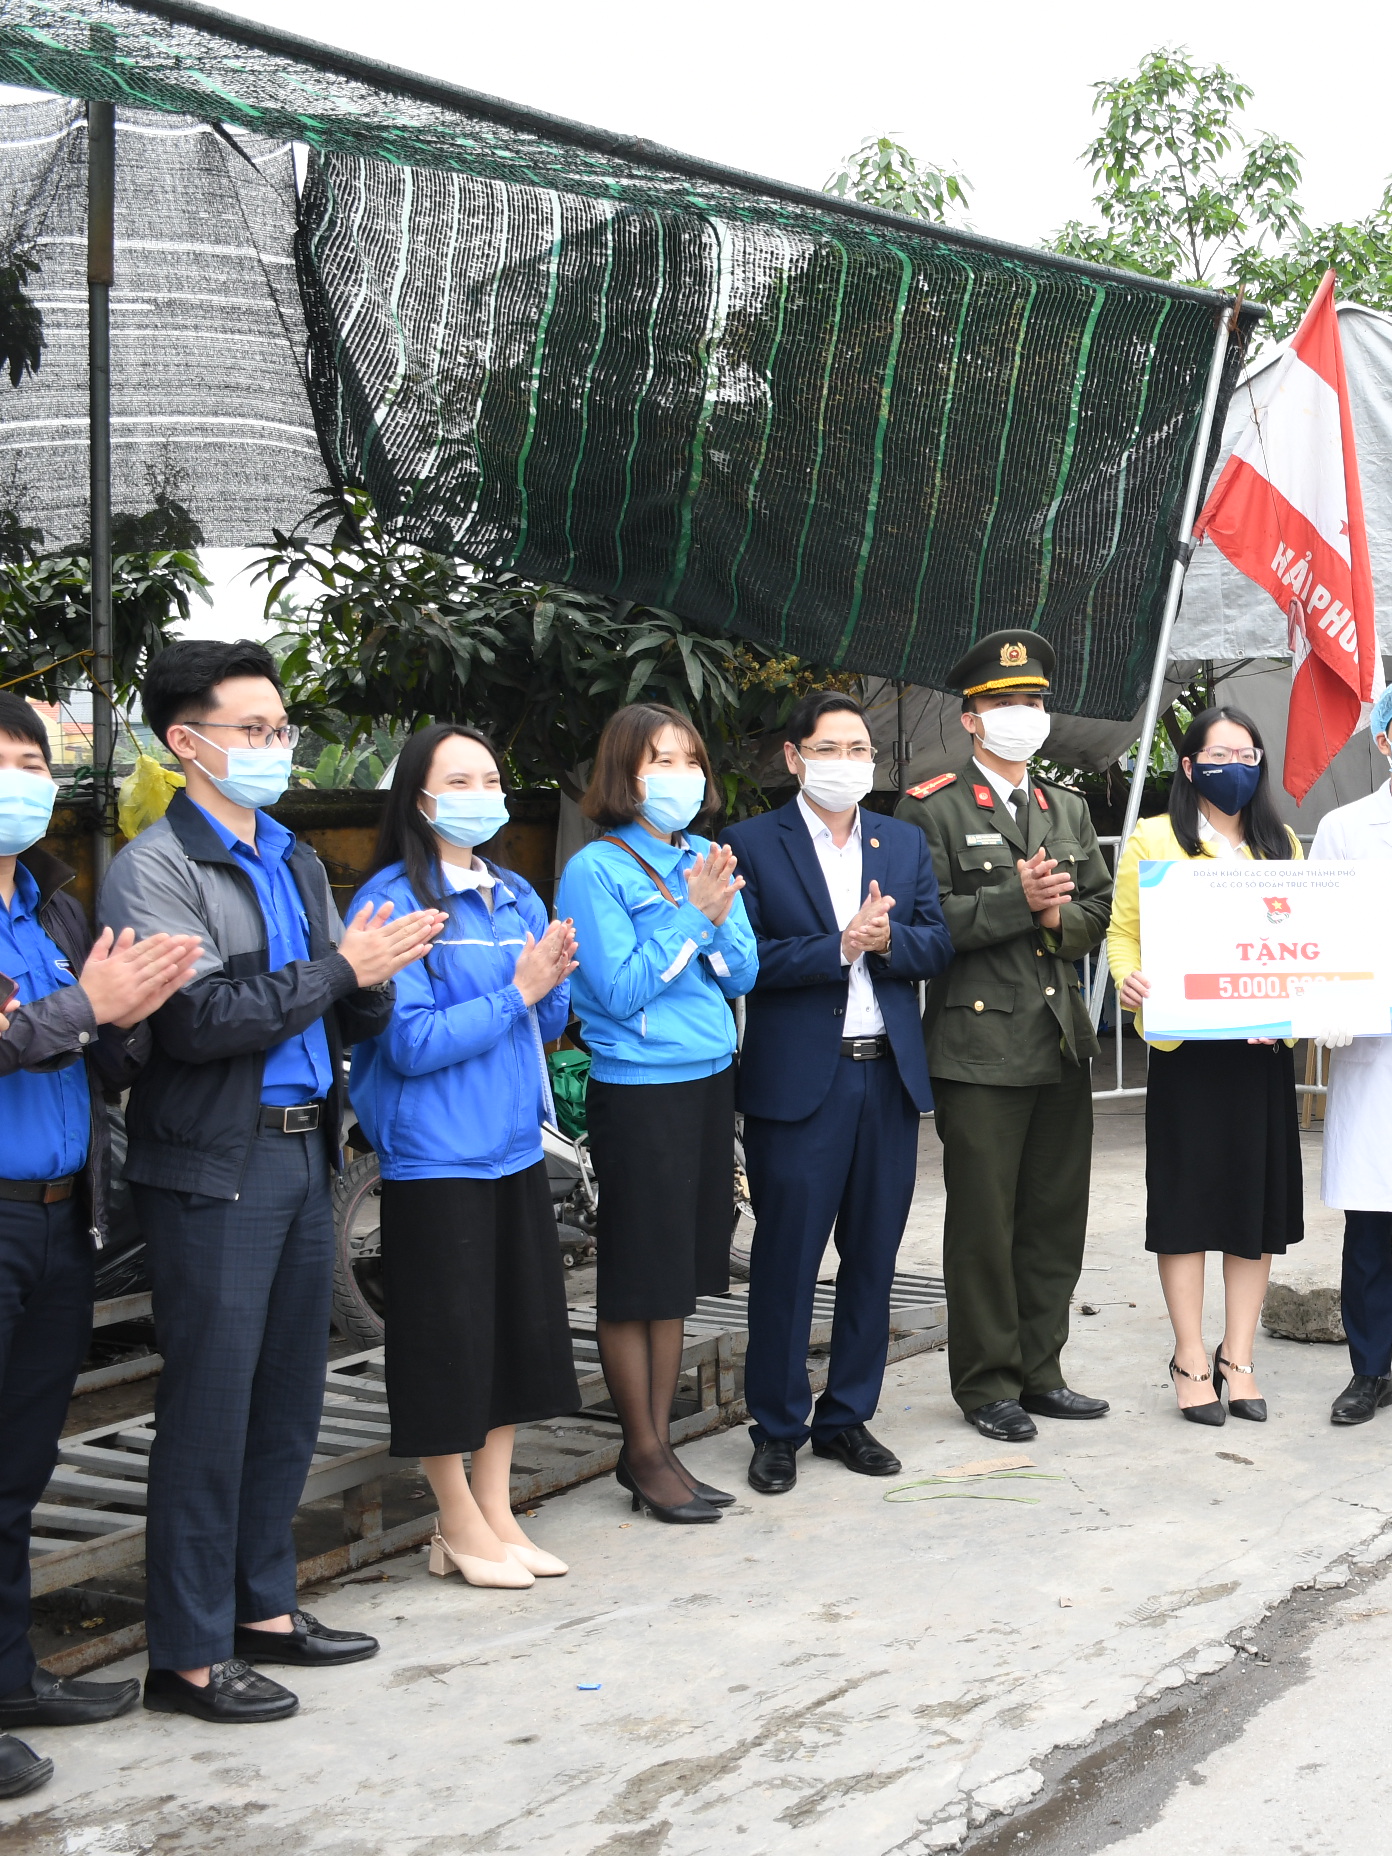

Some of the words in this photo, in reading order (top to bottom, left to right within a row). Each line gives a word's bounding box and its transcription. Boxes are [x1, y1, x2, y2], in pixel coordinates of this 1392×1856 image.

[1270, 541, 1313, 602] HẢI
[1307, 584, 1359, 664] PHO
[1235, 937, 1320, 966] TẶNG
